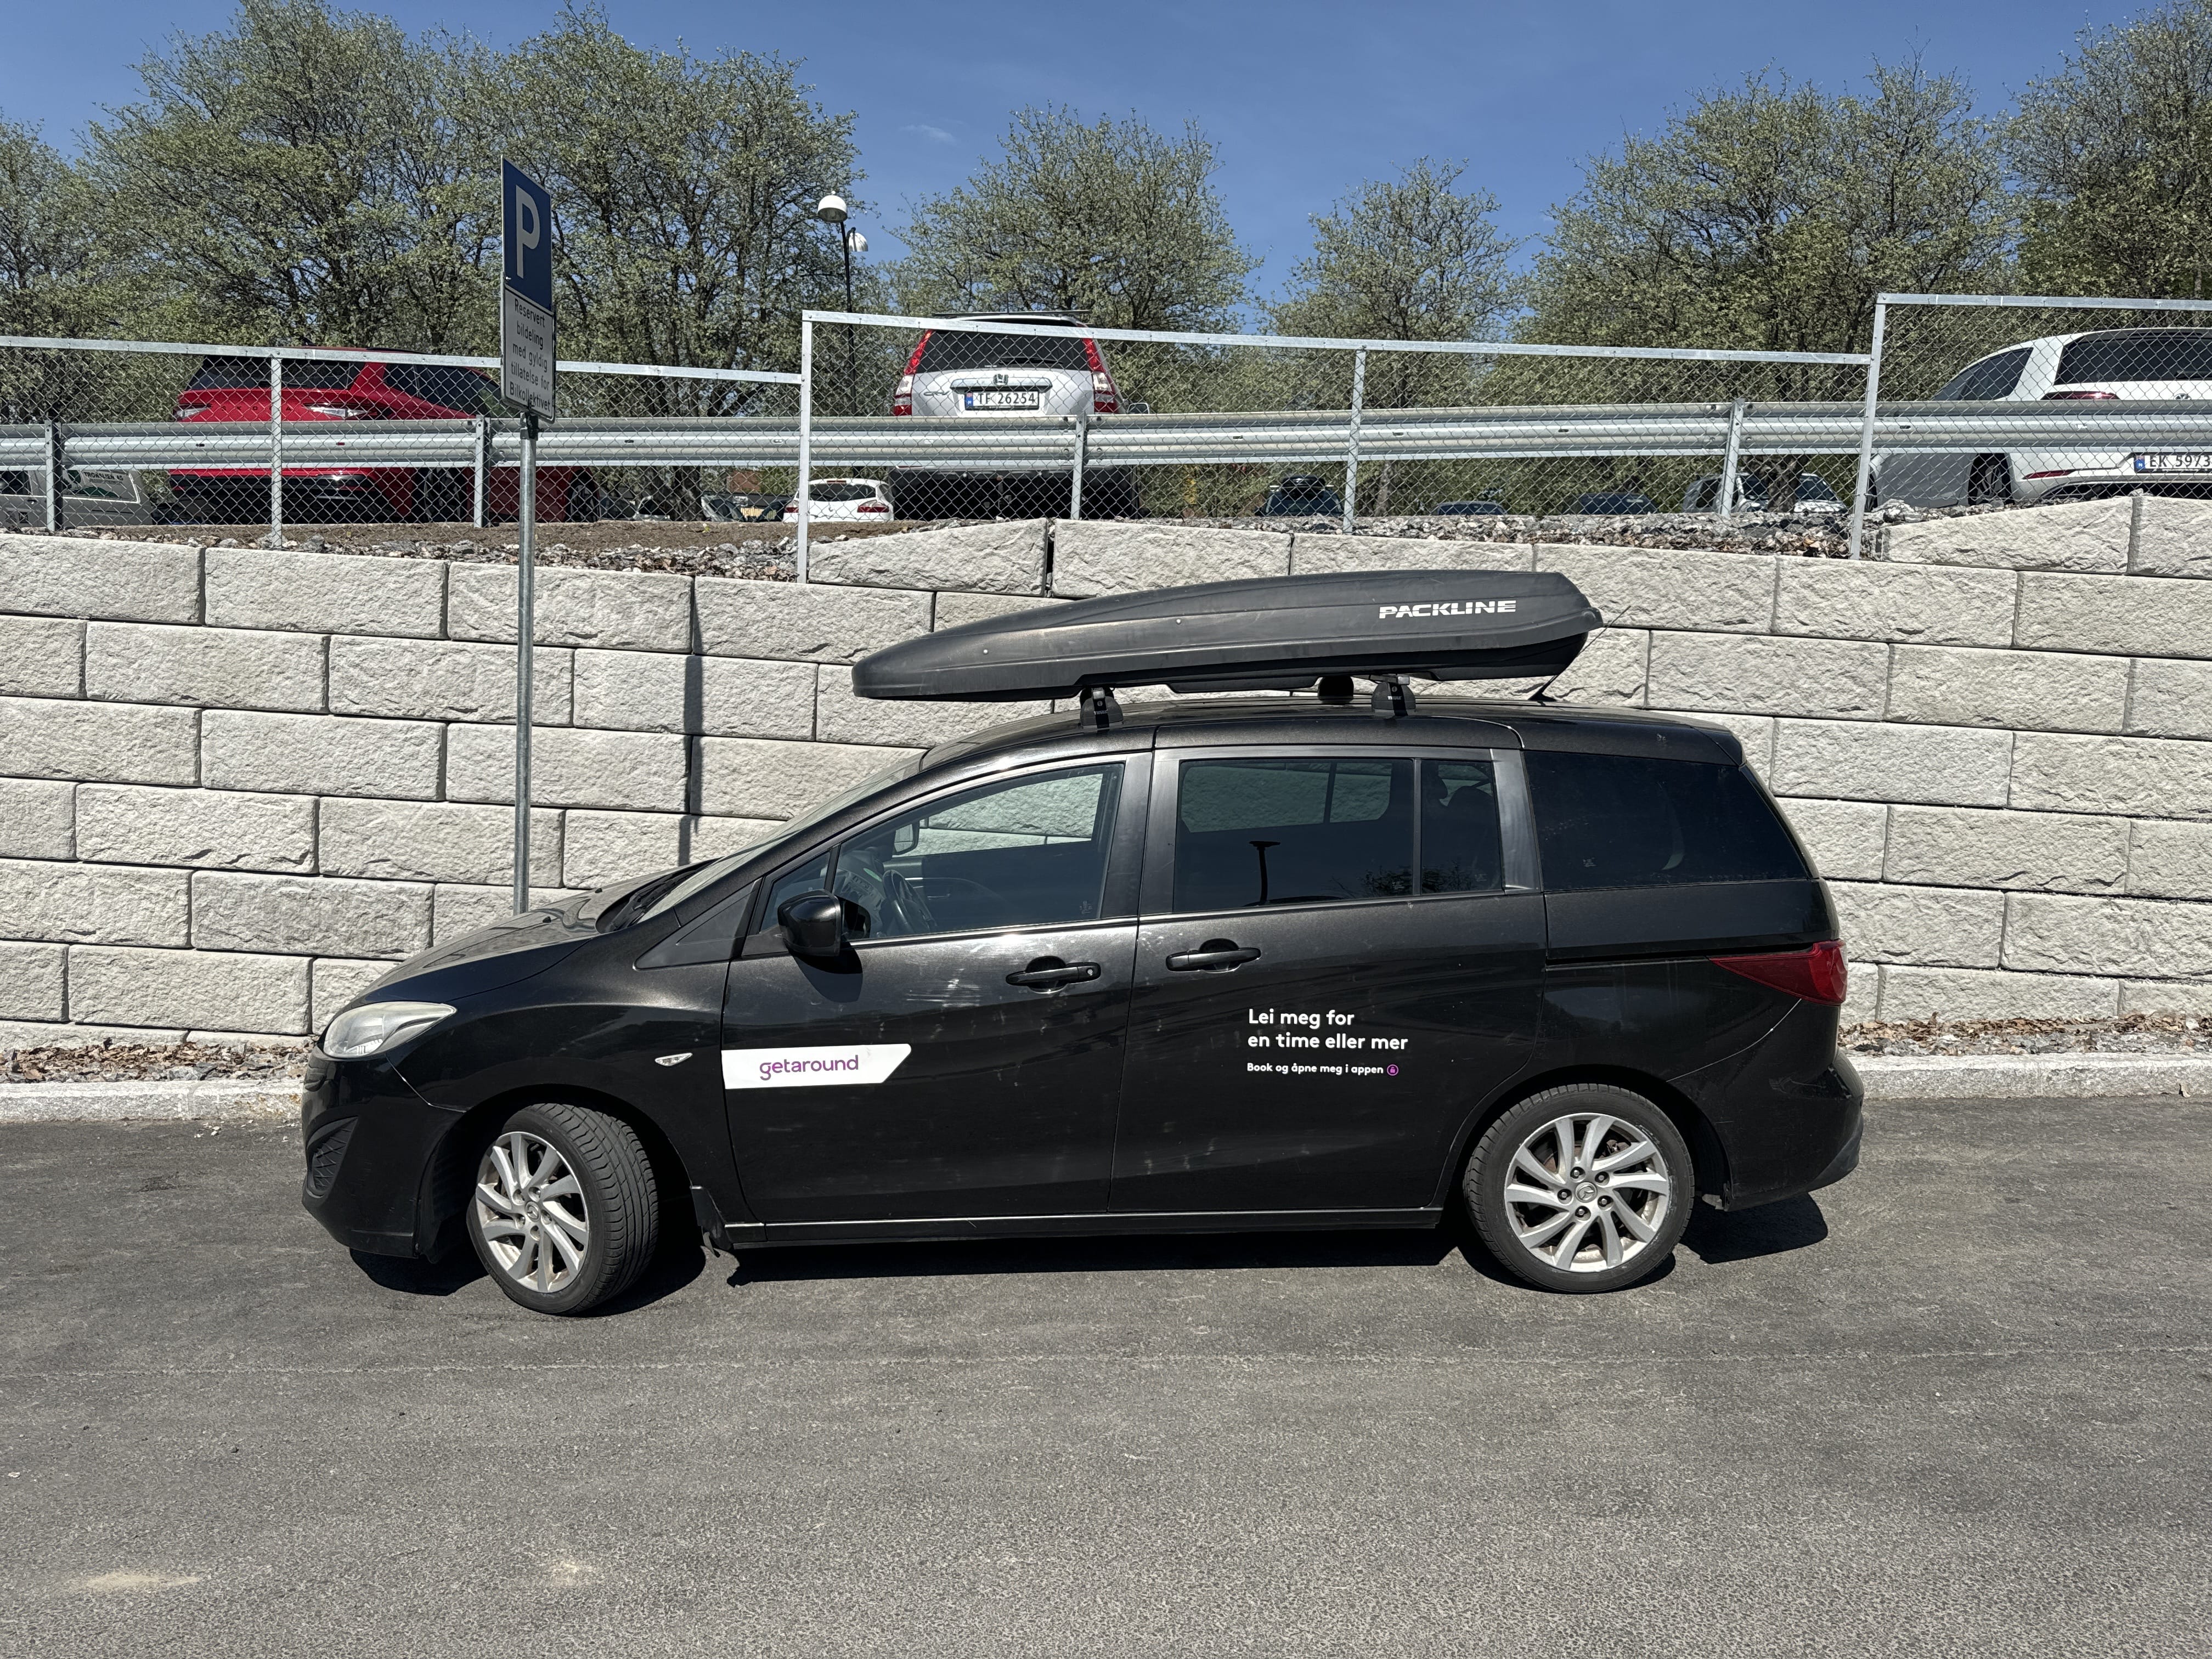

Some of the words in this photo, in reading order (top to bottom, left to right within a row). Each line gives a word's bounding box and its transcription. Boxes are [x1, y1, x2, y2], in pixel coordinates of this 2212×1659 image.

[516, 184, 540, 279] P
[515, 298, 545, 328] Reservert
[517, 320, 543, 351] bildeling
[512, 343, 526, 359] med
[528, 352, 548, 373] gyldig
[511, 361, 538, 386] tillatelse
[541, 375, 550, 391] for
[510, 381, 550, 412] Bilkollektivet
[978, 393, 991, 404] TF
[997, 392, 1036, 405] 26254
[2149, 455, 2168, 467] EK
[2175, 454, 2211, 467] 5973
[1379, 600, 1516, 619] PACKLINE
[1249, 1008, 1274, 1024] Lei
[1280, 1013, 1321, 1030] meg
[1326, 1009, 1355, 1025] for
[1248, 1036, 1270, 1047] en
[1275, 1031, 1320, 1048] time
[1325, 1033, 1365, 1049] eller
[1371, 1038, 1408, 1049] mer
[759, 1054, 859, 1081] getaround
[1247, 1062, 1273, 1072] Book
[1275, 1065, 1289, 1074] og
[1291, 1063, 1317, 1075] åpne
[1319, 1066, 1342, 1075] meg
[1345, 1064, 1349, 1073] i
[1351, 1066, 1384, 1076] appen
